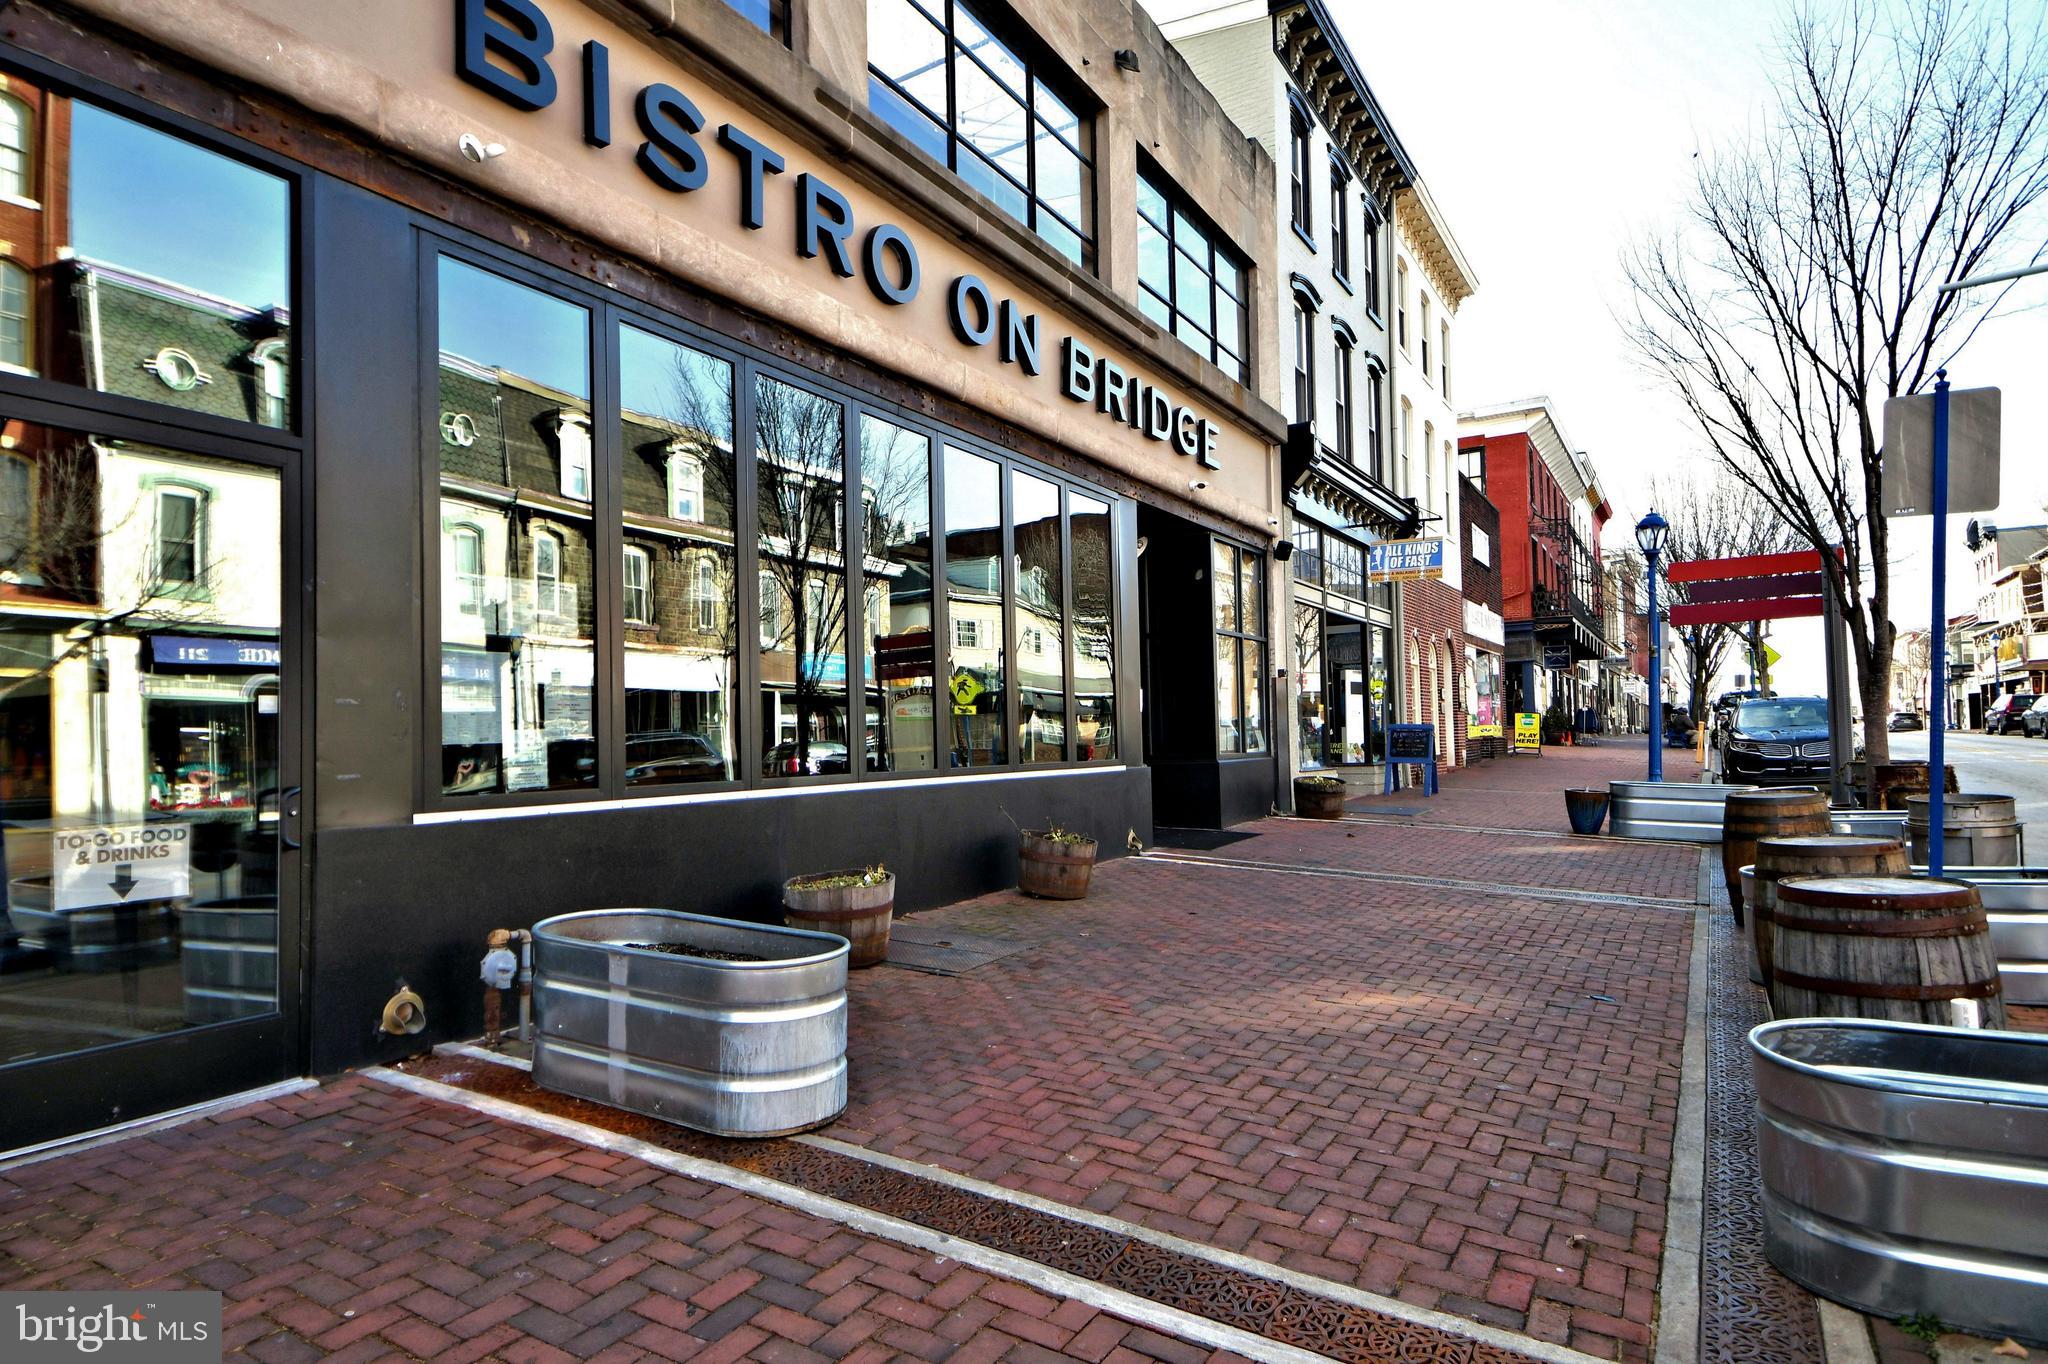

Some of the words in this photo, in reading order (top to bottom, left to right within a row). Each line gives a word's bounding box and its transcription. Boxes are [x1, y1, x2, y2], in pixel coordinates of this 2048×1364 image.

[455, 0, 921, 304] BISTRO
[948, 274, 1040, 376] ON
[1062, 336, 1222, 469] BRIDGE
[1385, 545, 1402, 557] ALL
[1405, 541, 1439, 556] KINDS
[1390, 556, 1404, 569] OF
[1405, 554, 1432, 568] FAST
[56, 832, 125, 850] TO-GO
[131, 828, 187, 844] FOOD
[75, 850, 91, 865] &
[97, 845, 170, 863] DRINKS
